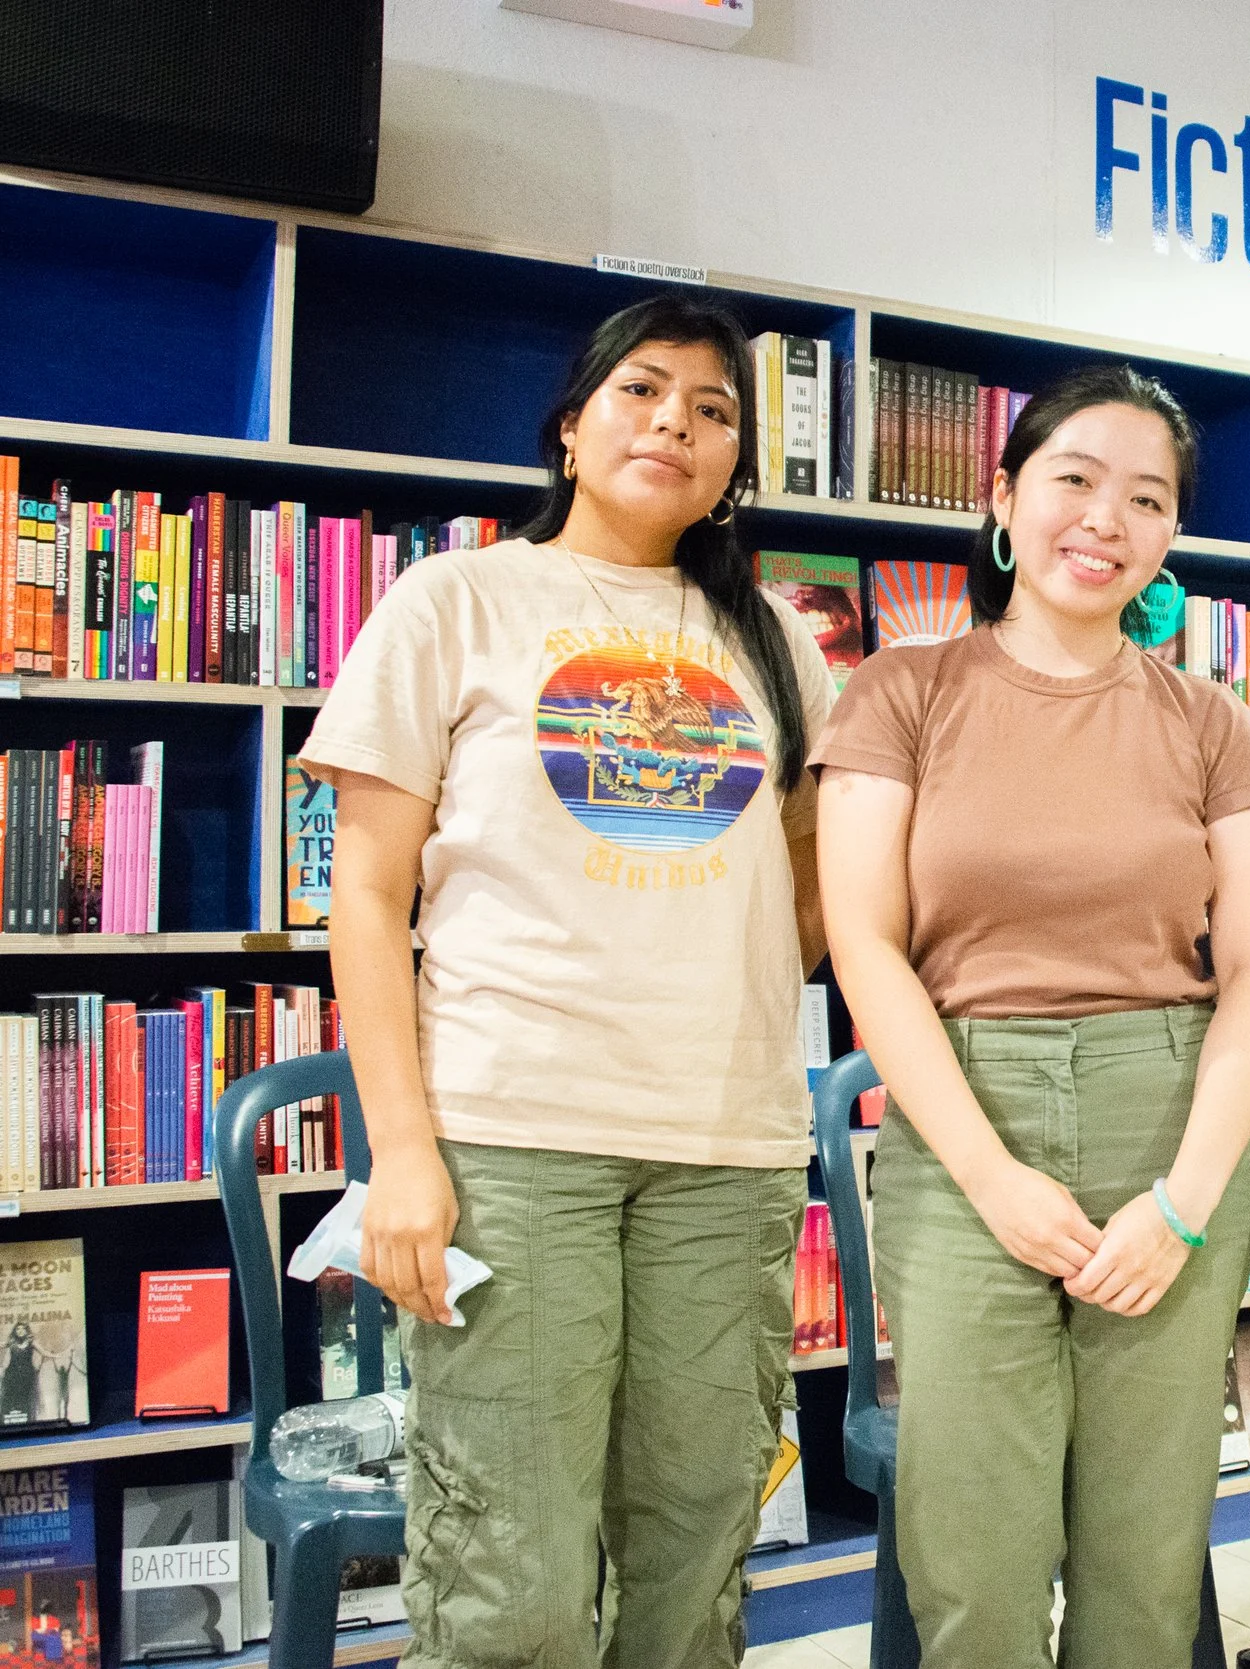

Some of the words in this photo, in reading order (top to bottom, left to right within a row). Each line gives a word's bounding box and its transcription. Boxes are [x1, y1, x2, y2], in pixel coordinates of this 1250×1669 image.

[602, 256, 629, 271] Fiction
[629, 260, 636, 272] &
[637, 262, 663, 277] poetry
[664, 264, 705, 281] overstock
[796, 386, 807, 397] THE
[791, 402, 812, 414] BOOKS
[798, 420, 805, 430] OF
[791, 438, 811, 448] JACOB
[59, 486, 69, 512] CHEN
[141, 505, 150, 536] CITIZENS
[149, 505, 158, 550] FRAGMENTED
[212, 497, 222, 554] HALBERSTAM
[282, 512, 291, 543] Queer
[55, 524, 69, 596] Animacies
[120, 532, 129, 579] DISRUPTING
[211, 559, 220, 592] FEMALE
[772, 567, 857, 583] REVOLTING!
[118, 581, 127, 614] DIGNITY
[210, 595, 219, 654] MASCULINITY
[95, 785, 105, 806] AND
[61, 821, 71, 836] BODY
[92, 820, 104, 876] CATEGORY
[583, 845, 729, 890] Unidos
[68, 1008, 76, 1040] CALIBAN
[260, 991, 268, 1046] HALBERSTAM
[811, 1000, 820, 1023] DEEP
[812, 1025, 822, 1066] SECRETS
[189, 1061, 201, 1111] Achieve
[10, 1259, 72, 1276] MOON
[148, 1292, 183, 1303] Painting
[149, 1284, 169, 1292] Mad
[169, 1283, 193, 1291] about
[16, 1309, 72, 1322] MALINA
[147, 1314, 181, 1323] Hokusai
[148, 1304, 192, 1313] Katsushika
[132, 1548, 230, 1582] BARTHES
